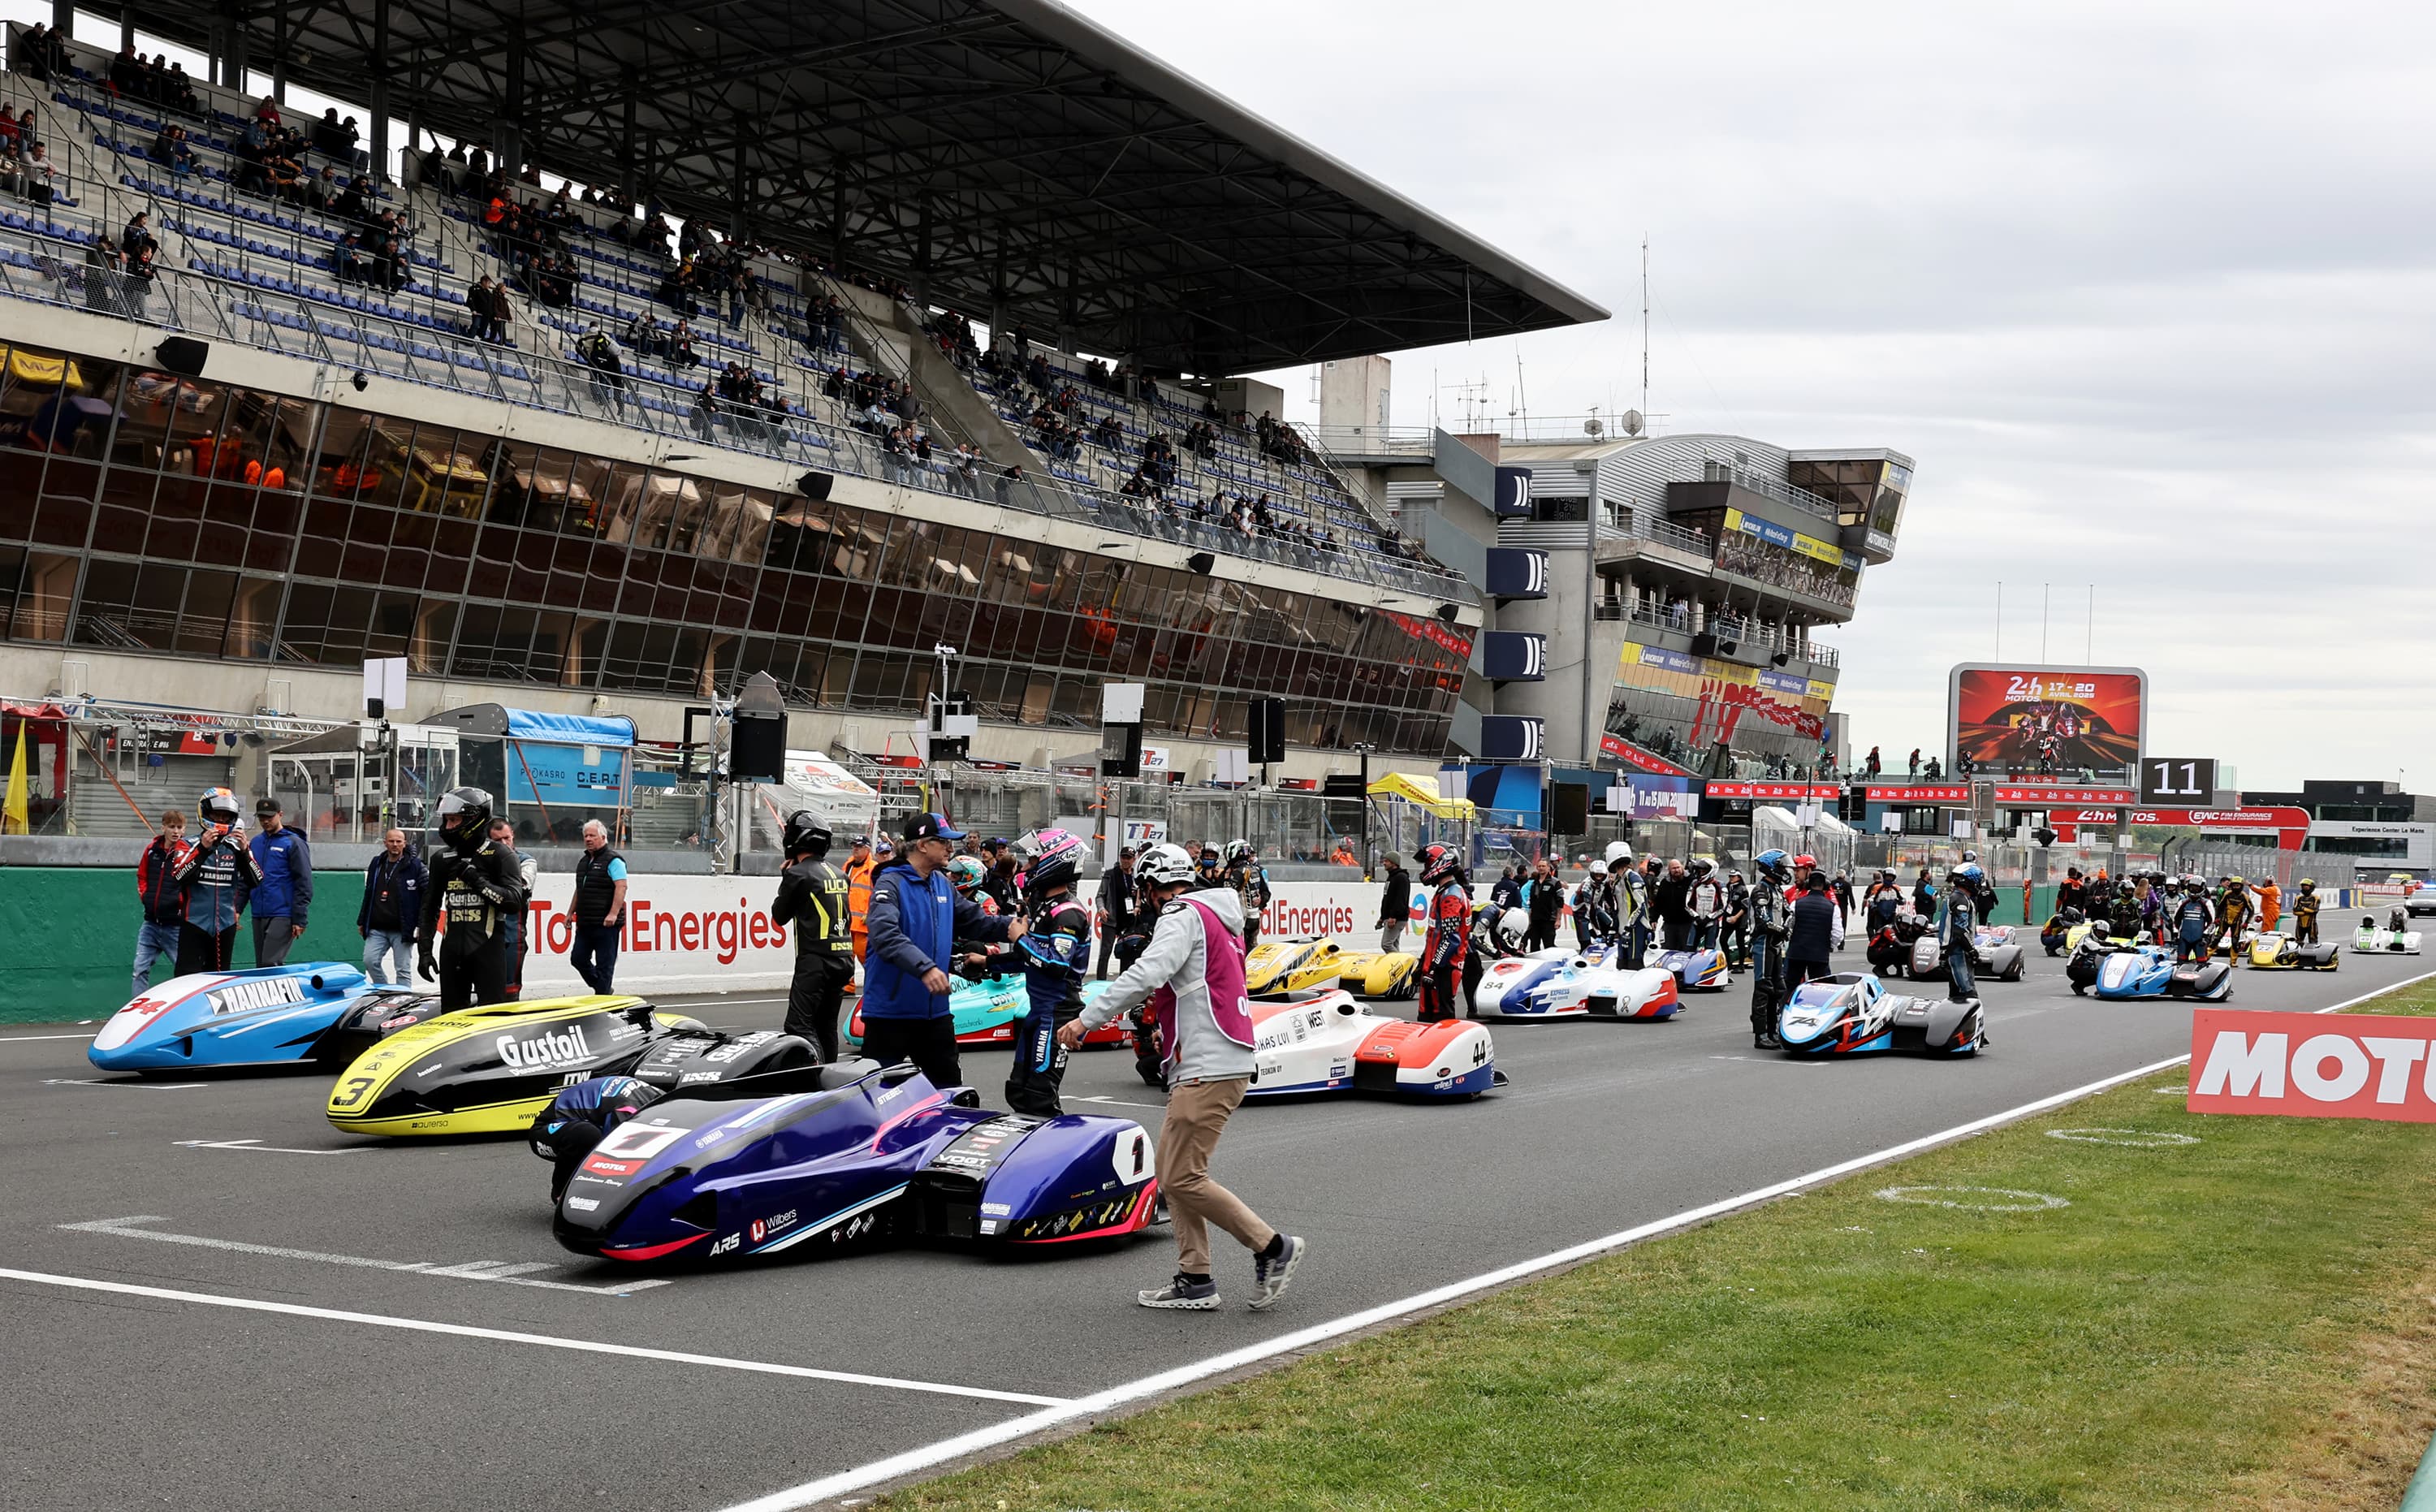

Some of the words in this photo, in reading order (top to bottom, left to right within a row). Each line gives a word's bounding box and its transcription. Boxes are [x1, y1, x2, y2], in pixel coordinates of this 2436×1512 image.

[2049, 682, 2064, 691] 17
[2075, 683, 2095, 692] 20
[2153, 761, 2203, 795] 11
[529, 896, 787, 965] TolEnergies
[221, 977, 306, 1014] HANNAFIN
[1484, 981, 1504, 990] 84
[119, 997, 167, 1015] 34
[1305, 1009, 1326, 1029] WEST
[1787, 1016, 1819, 1027] 74
[496, 1024, 591, 1068] Gustoil
[1034, 1029, 1050, 1063] YAMAHA
[1473, 1039, 1486, 1067] 44
[563, 1069, 592, 1086] ITW
[332, 1078, 376, 1106] 3
[877, 1086, 903, 1105] STIEBEL
[611, 1131, 673, 1151] 1
[702, 1130, 725, 1146] YAMAHA
[939, 1154, 992, 1166] VOGT
[1131, 1133, 1144, 1177] 1
[592, 1161, 628, 1172] MOTUL
[767, 1208, 797, 1229] Wilbers
[709, 1232, 741, 1257] ARS
